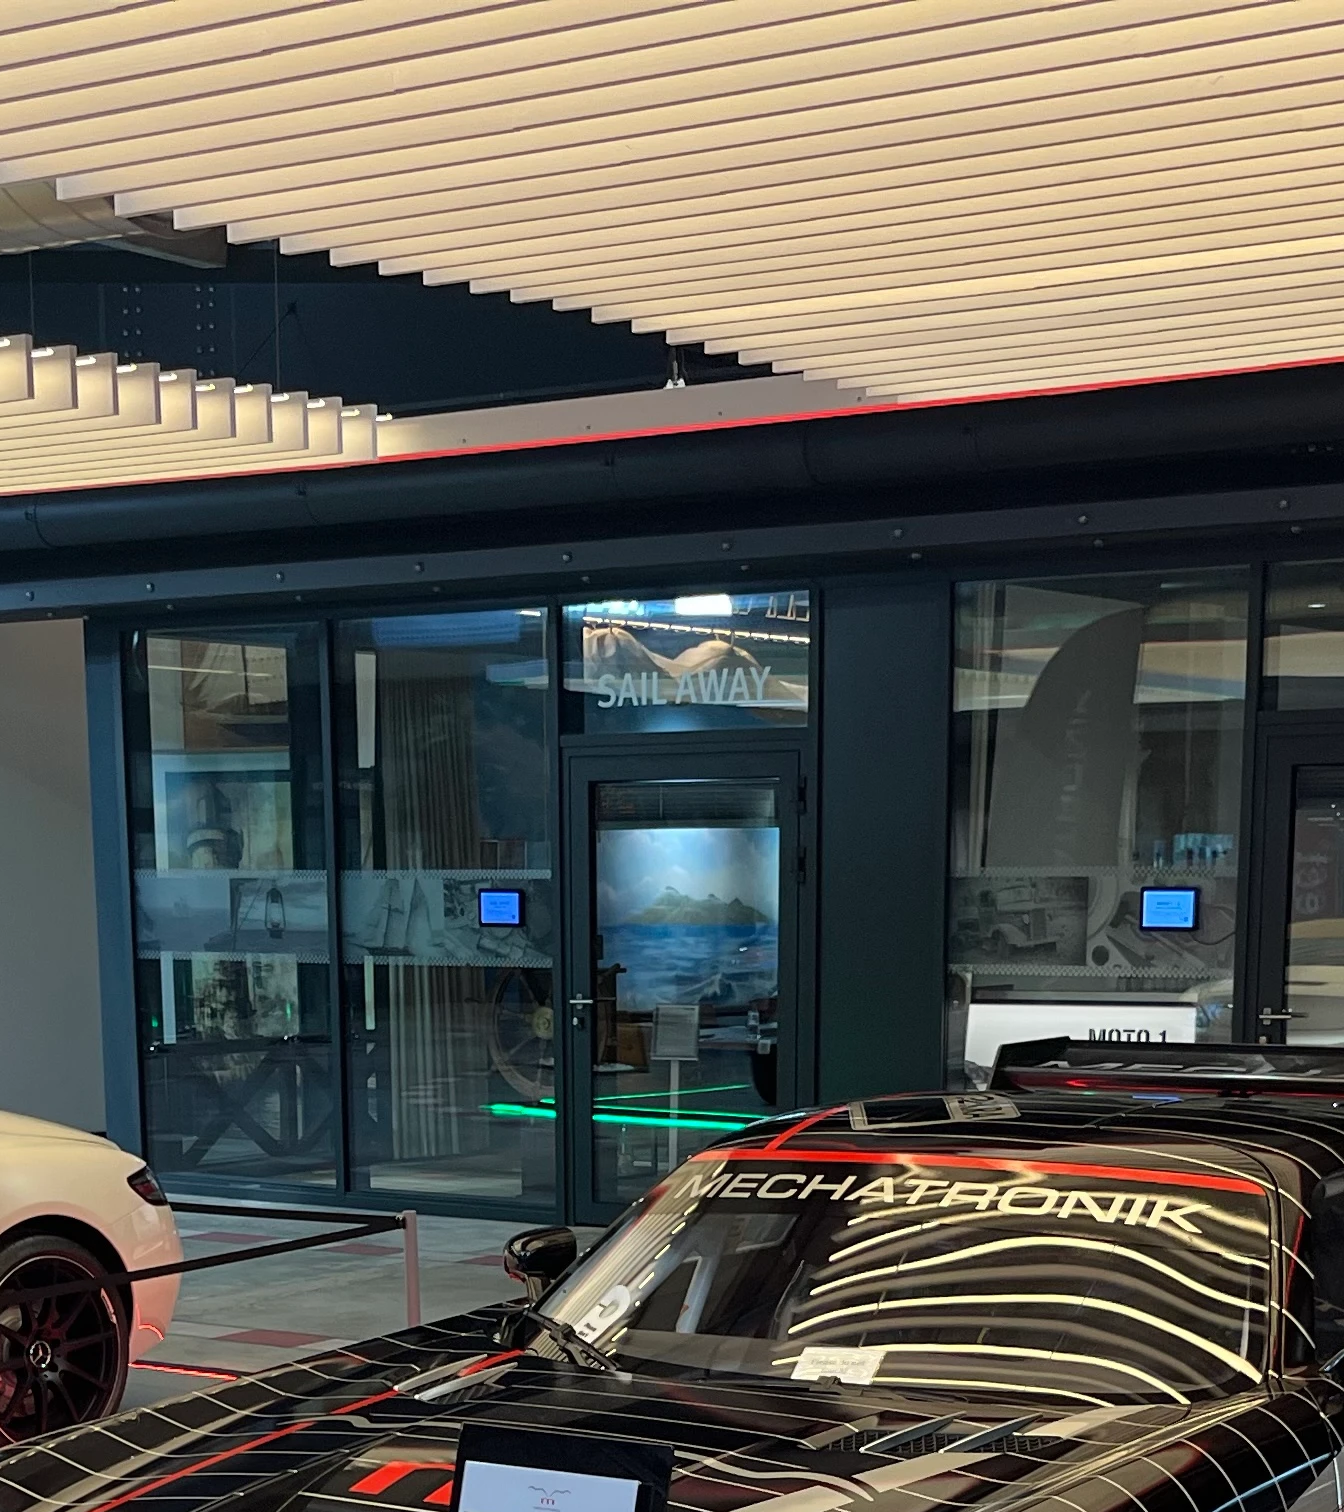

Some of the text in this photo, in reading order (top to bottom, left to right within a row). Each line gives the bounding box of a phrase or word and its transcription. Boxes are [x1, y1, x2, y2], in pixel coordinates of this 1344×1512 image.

[597, 666, 771, 708] SAIL AWAY
[674, 1172, 1211, 1234] MECHATRONIK
